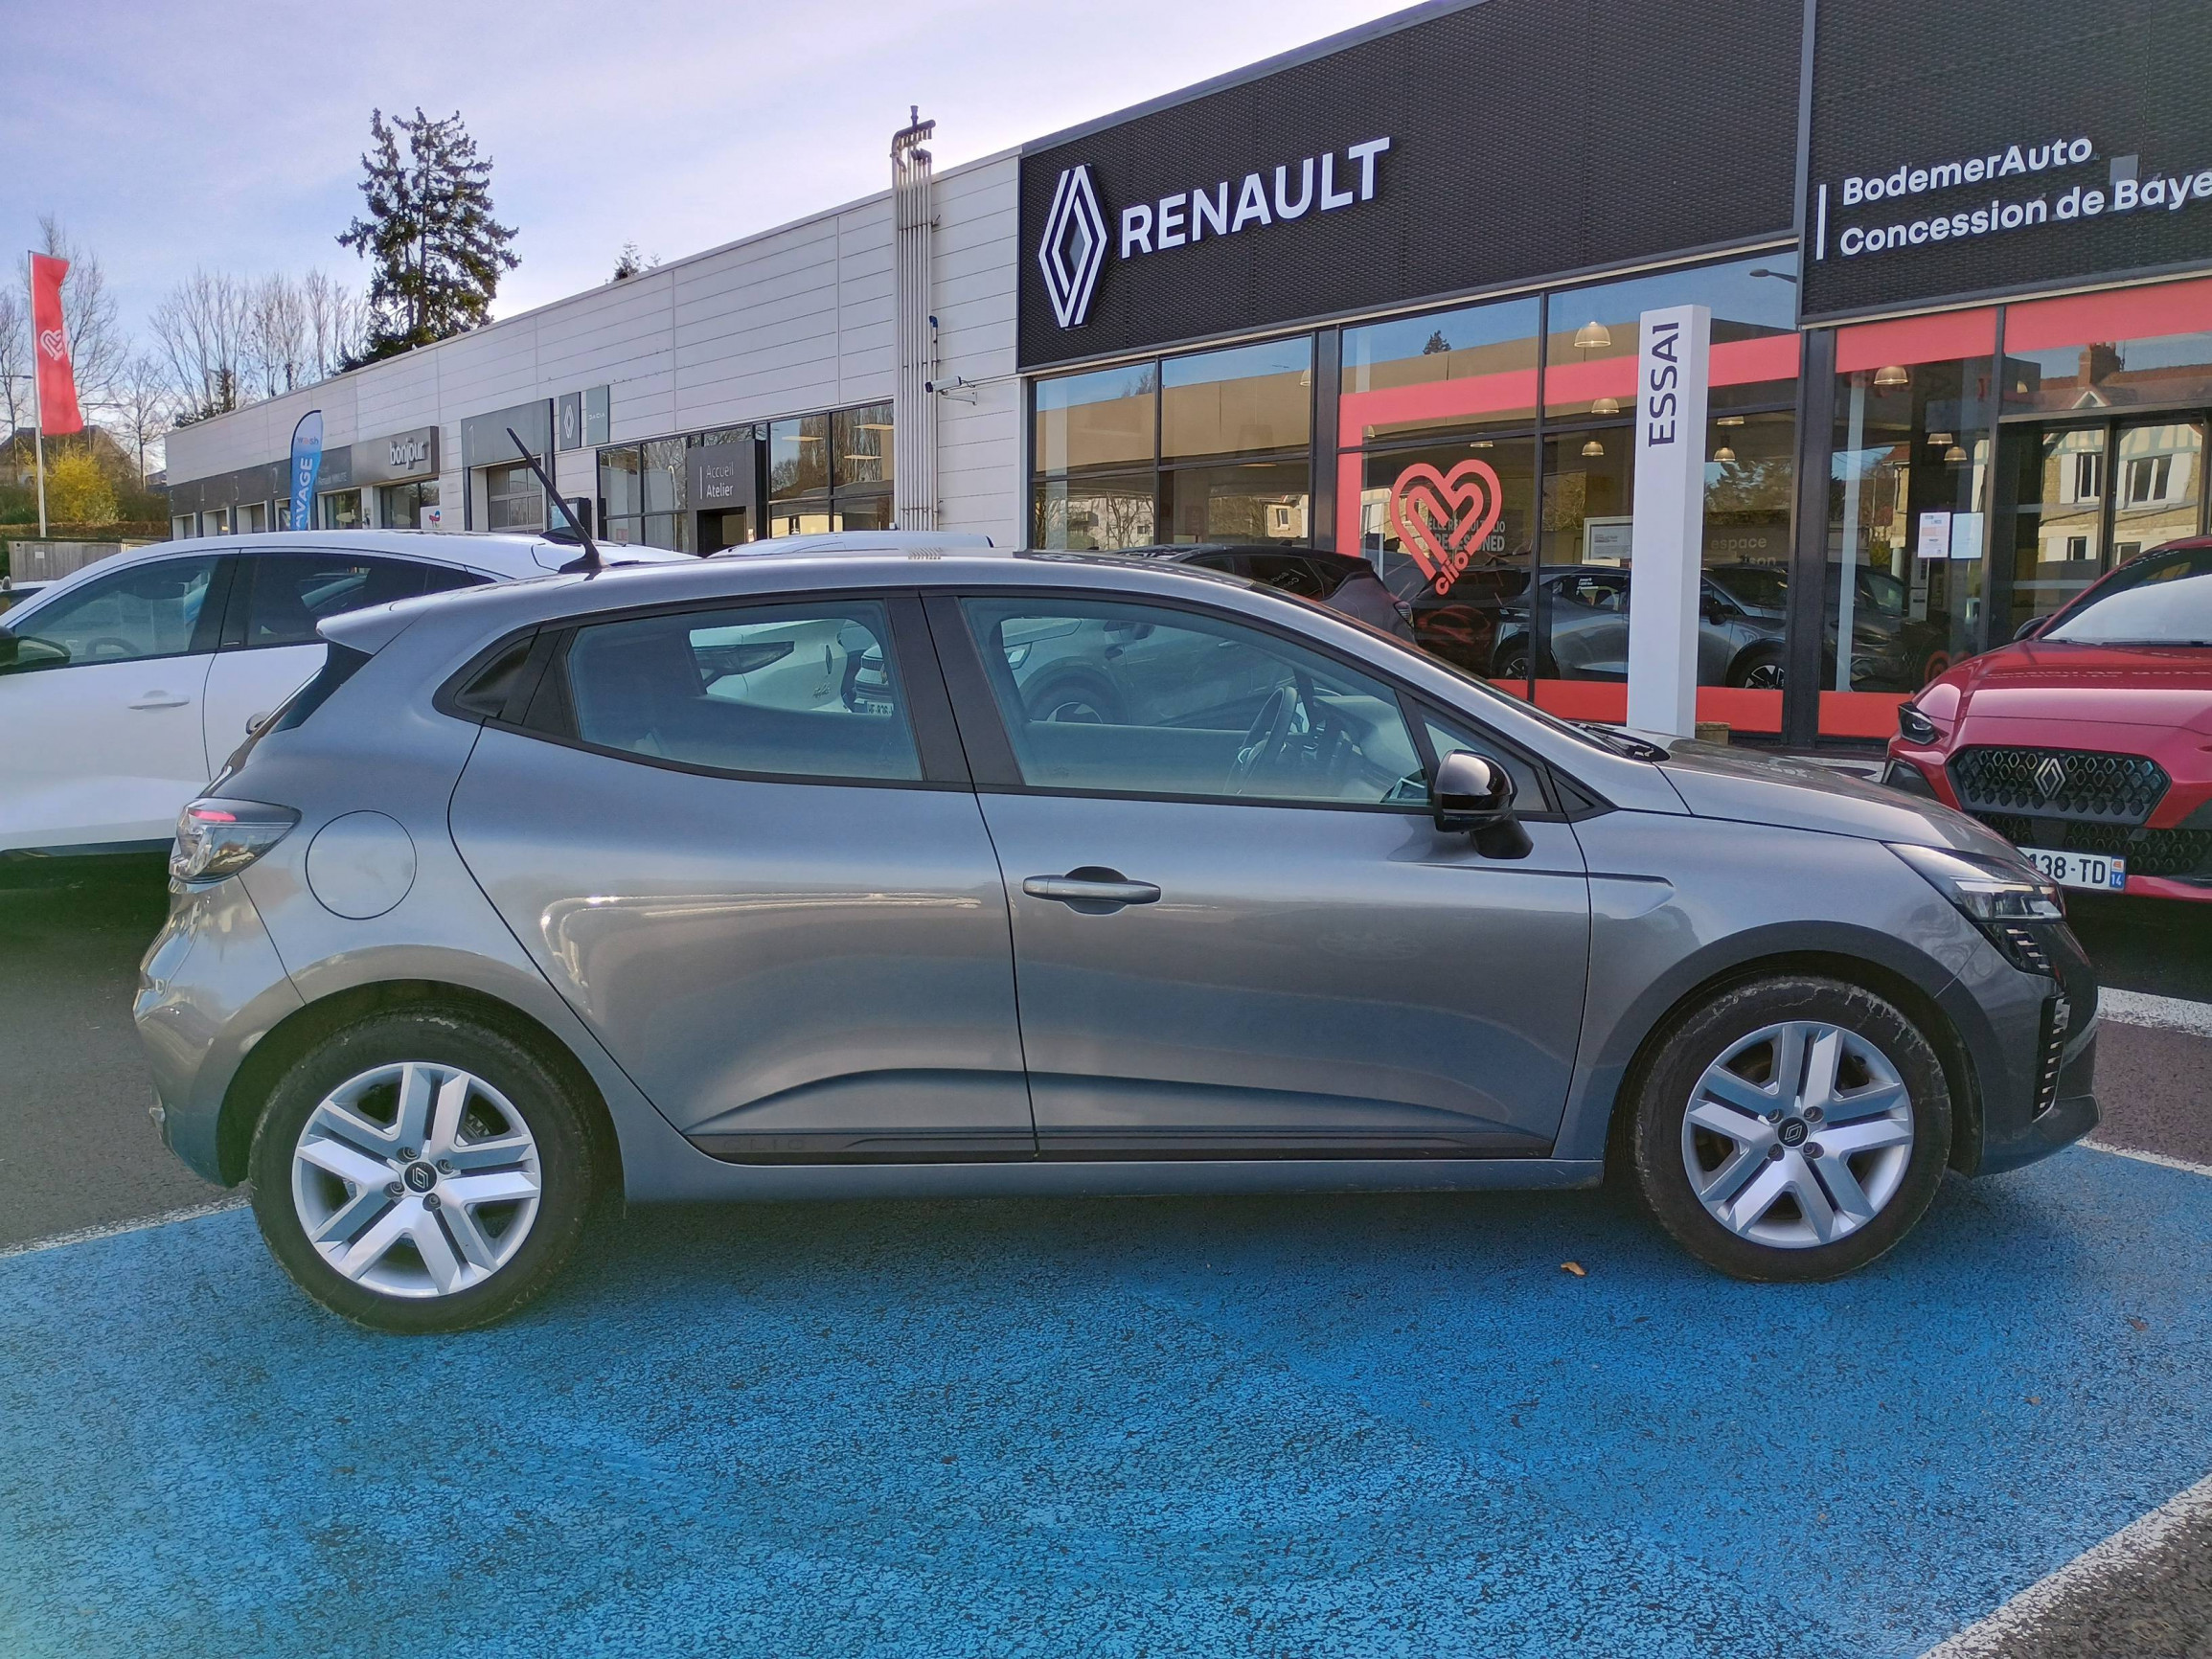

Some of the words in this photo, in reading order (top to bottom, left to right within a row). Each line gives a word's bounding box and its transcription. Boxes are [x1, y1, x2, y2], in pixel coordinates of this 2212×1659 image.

[1842, 136, 2093, 206] BodemerAuto
[1121, 136, 1391, 260] RENAULT
[1839, 198, 2047, 256] Concession
[2056, 185, 2106, 218] de
[1648, 322, 1679, 448] ESSAI
[389, 437, 425, 470] bonjour
[706, 462, 734, 479] Accueil
[706, 483, 734, 498] Atelier
[1710, 537, 1767, 552] espace
[1435, 552, 1469, 596] clio
[2110, 874, 2122, 886] 14
